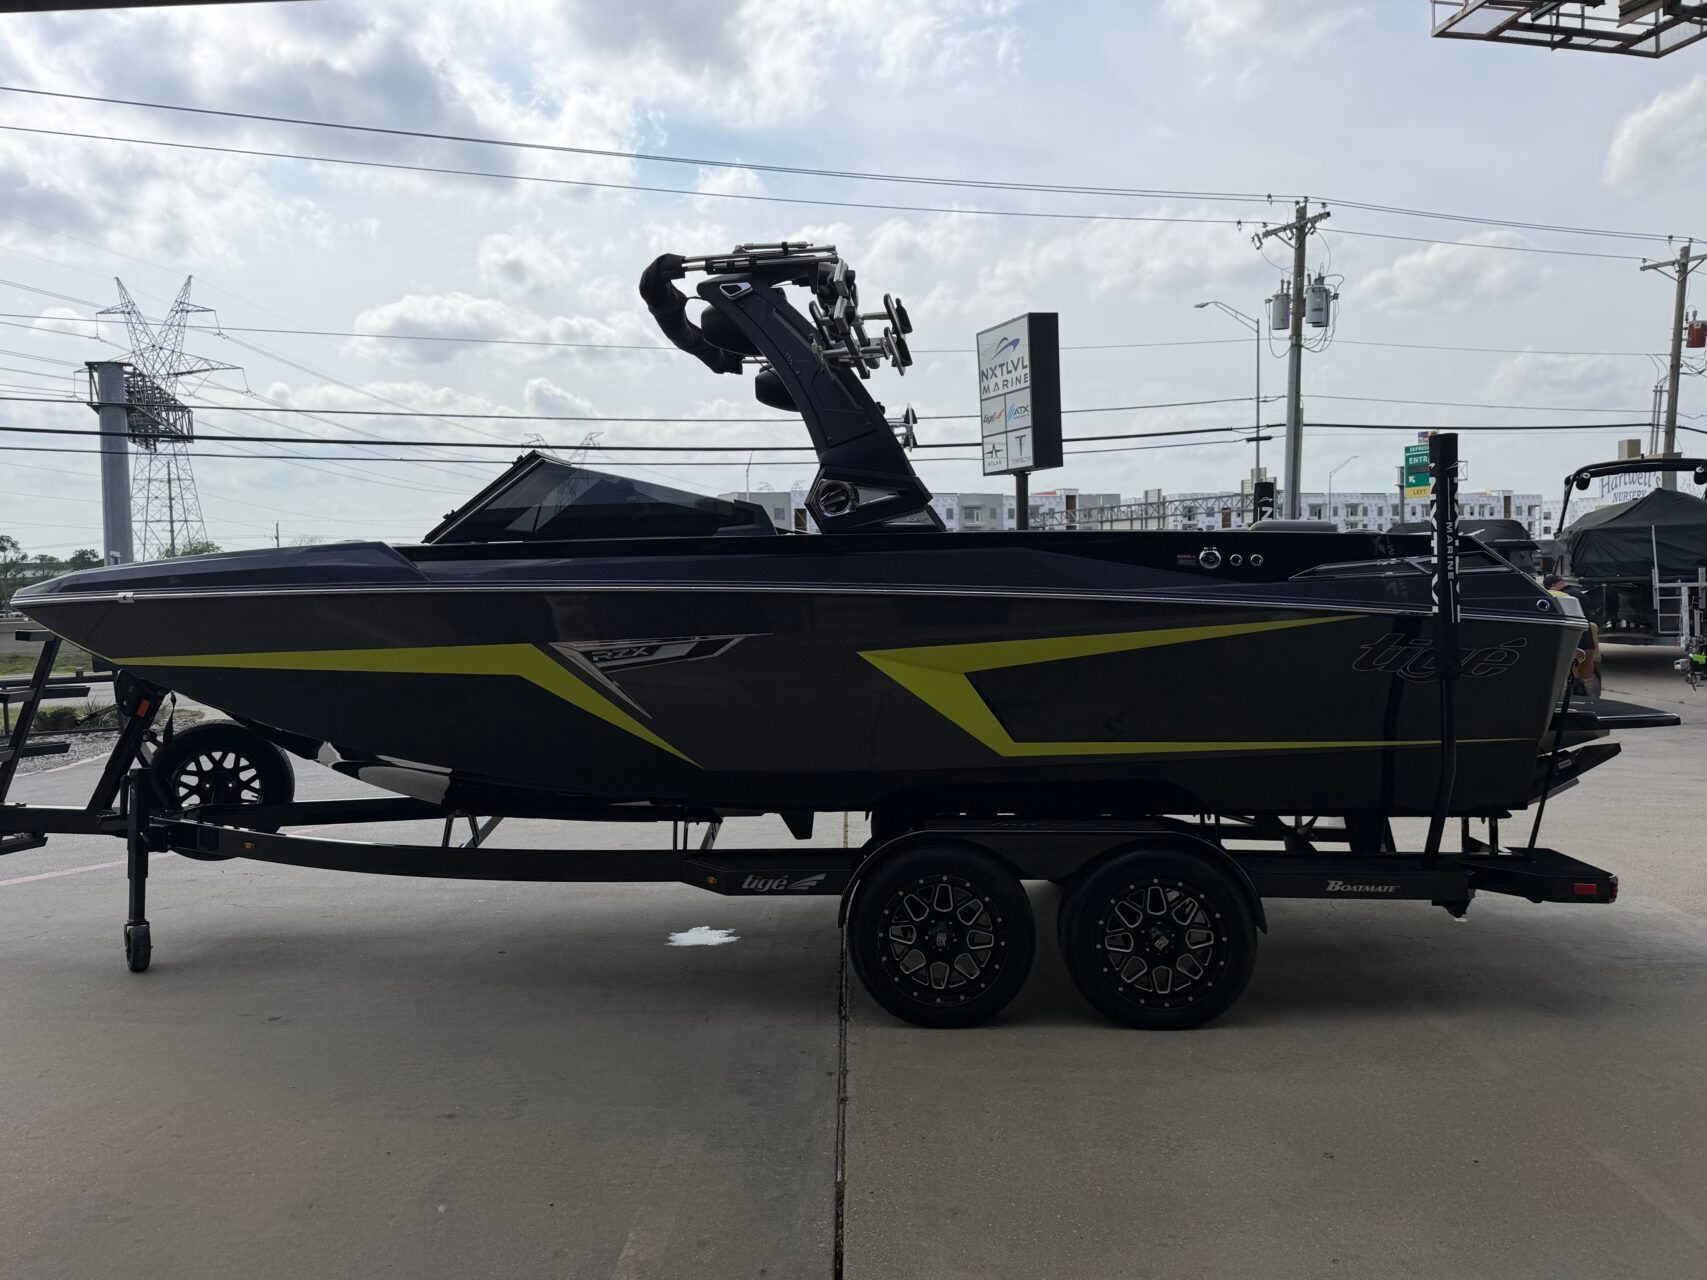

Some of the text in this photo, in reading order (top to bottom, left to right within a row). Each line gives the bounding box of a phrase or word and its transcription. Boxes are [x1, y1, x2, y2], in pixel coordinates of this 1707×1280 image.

[981, 356, 1028, 382] NXTLVL
[982, 373, 1029, 395] MARINE
[1014, 404, 1029, 416] ATX
[1413, 488, 1427, 496] LEFT
[1446, 521, 1455, 580] MARINE
[592, 646, 649, 662] RZX
